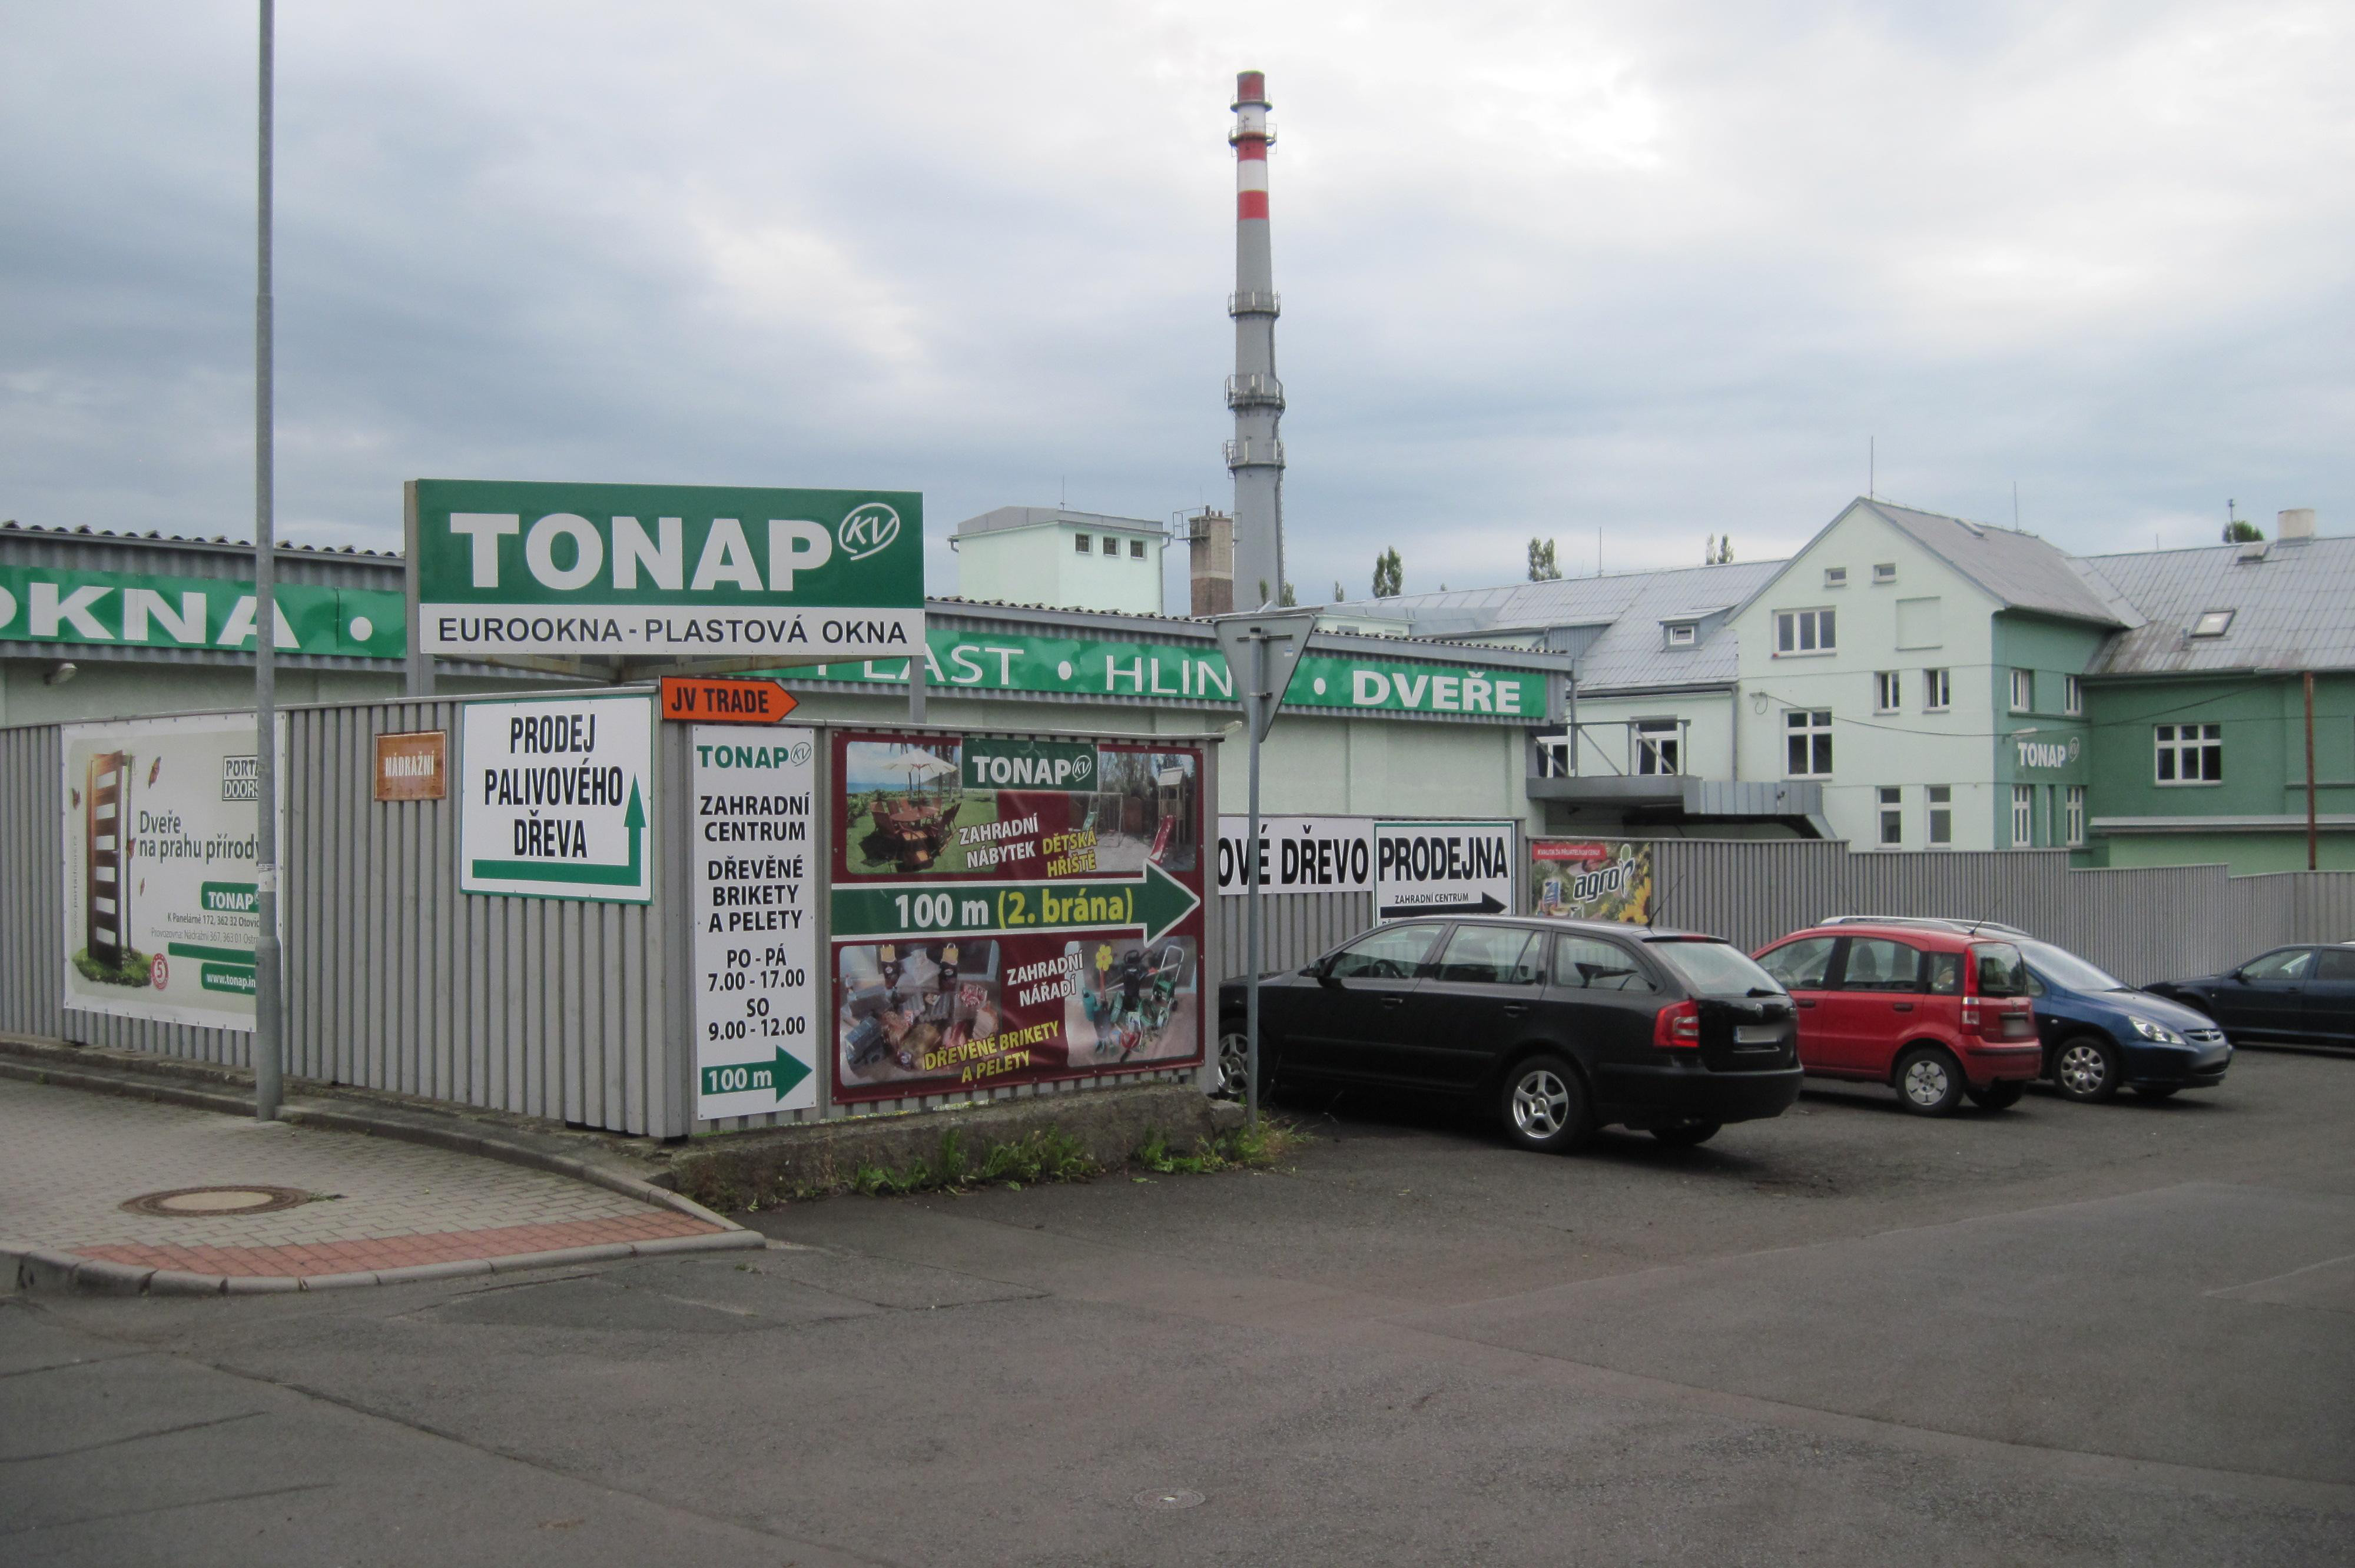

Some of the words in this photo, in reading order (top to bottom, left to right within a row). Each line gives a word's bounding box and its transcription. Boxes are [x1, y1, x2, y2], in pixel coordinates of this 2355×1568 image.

[450, 512, 832, 592] TONAP
[0, 583, 301, 648] KNA
[438, 617, 623, 643] EUROOKNA
[645, 613, 807, 643] PLASTOVÁ
[822, 620, 908, 644] OKNA
[818, 643, 1024, 685] LAST
[1353, 670, 1521, 713] DVEŘE
[671, 687, 696, 712] JV
[704, 687, 769, 713] TRADE
[510, 713, 596, 754] PRODEJ
[386, 750, 434, 777] NÁDRAŽNÍ
[696, 745, 789, 769] TONAP
[2017, 742, 2066, 768] TONAP
[484, 757, 623, 806] PALIVOVÉHO
[972, 755, 1072, 785] TONAP
[699, 792, 811, 816] ZAHRADNÍ
[140, 809, 181, 834] Dveře
[513, 809, 588, 858] DŘEVA
[704, 821, 806, 842] CENTRUM
[958, 812, 1039, 846] ZAHRADNÍ
[140, 839, 157, 857] na
[160, 832, 202, 864] prahu
[1042, 825, 1098, 856] DĚTSKÁ
[708, 855, 804, 881] DŘEVĚNÉ
[966, 841, 1037, 869] NÁBYTEK
[1046, 852, 1097, 878] HŘIŠTĚ
[1281, 824, 1369, 885] DŘEVO
[1378, 836, 1509, 882] PRODEJNA
[208, 891, 254, 910] TONAP
[712, 884, 800, 906] BRIKETY
[895, 893, 953, 929] 100
[961, 898, 989, 927] m
[997, 889, 1035, 929] (2.
[1041, 888, 1133, 924] brána)
[1395, 891, 1434, 904] ZAHRADNÍ
[1435, 892, 1469, 903] CENTRUM
[167, 912, 172, 922] K
[203, 915, 216, 926] 172,
[217, 915, 228, 926] 362
[230, 916, 237, 926] 32
[708, 913, 724, 933] A
[729, 909, 803, 932] PELETY
[157, 961, 163, 978] 5
[727, 948, 751, 969] PO
[765, 943, 787, 967] PÁ
[1006, 948, 1084, 986] ZAHRADNÍ
[708, 971, 746, 992] 7.00
[760, 968, 805, 988] 17.00
[1019, 977, 1077, 1008] NÁŘADÍ
[746, 998, 770, 1018] SO
[708, 1020, 746, 1041] 9.00
[761, 1016, 806, 1037] 12.00
[924, 1033, 997, 1072] DŘEVĚNÉ
[999, 1020, 1060, 1052] BRIKETY
[708, 1068, 748, 1092] 100
[753, 1068, 772, 1088] m
[961, 1066, 973, 1083] A
[976, 1050, 1031, 1079] PELETY
